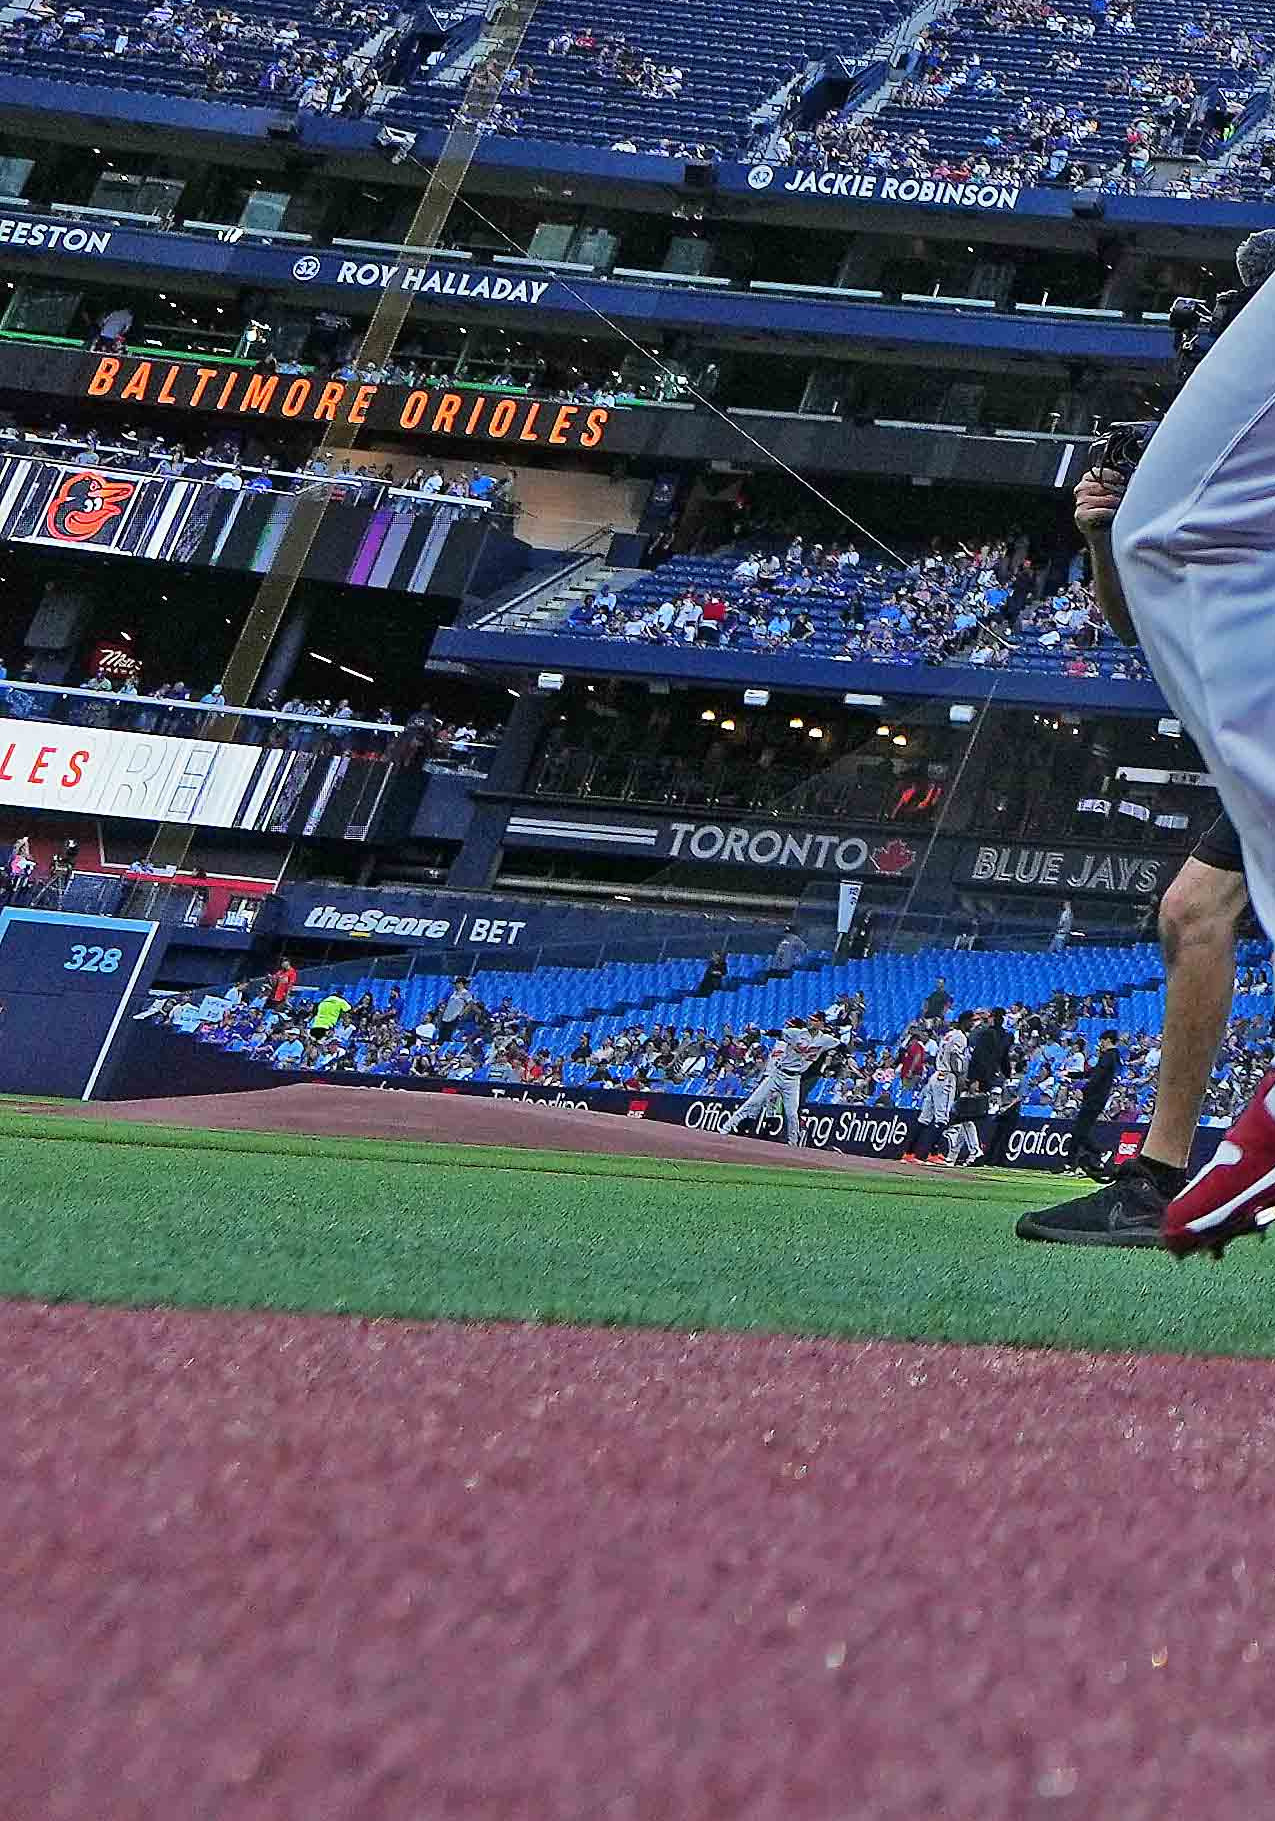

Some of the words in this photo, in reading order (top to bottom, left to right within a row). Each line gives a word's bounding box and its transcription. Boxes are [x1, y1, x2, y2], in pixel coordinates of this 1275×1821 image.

[785, 170, 875, 198] JACKIE
[881, 178, 1021, 209] ROBINSON
[0, 219, 112, 253] EESTON
[295, 259, 318, 277] 32
[337, 261, 400, 287] ROY
[401, 268, 549, 304] HALLADAY
[87, 357, 378, 424] BALTIMORE
[400, 389, 609, 447] ORIOLES
[669, 822, 868, 871] TORONTO
[971, 846, 1064, 885] BLUE
[1066, 854, 1162, 893] JAYS
[304, 906, 450, 938] theScore
[469, 918, 527, 945] BET
[63, 944, 123, 973] 328
[836, 1112, 908, 1152] Shingle
